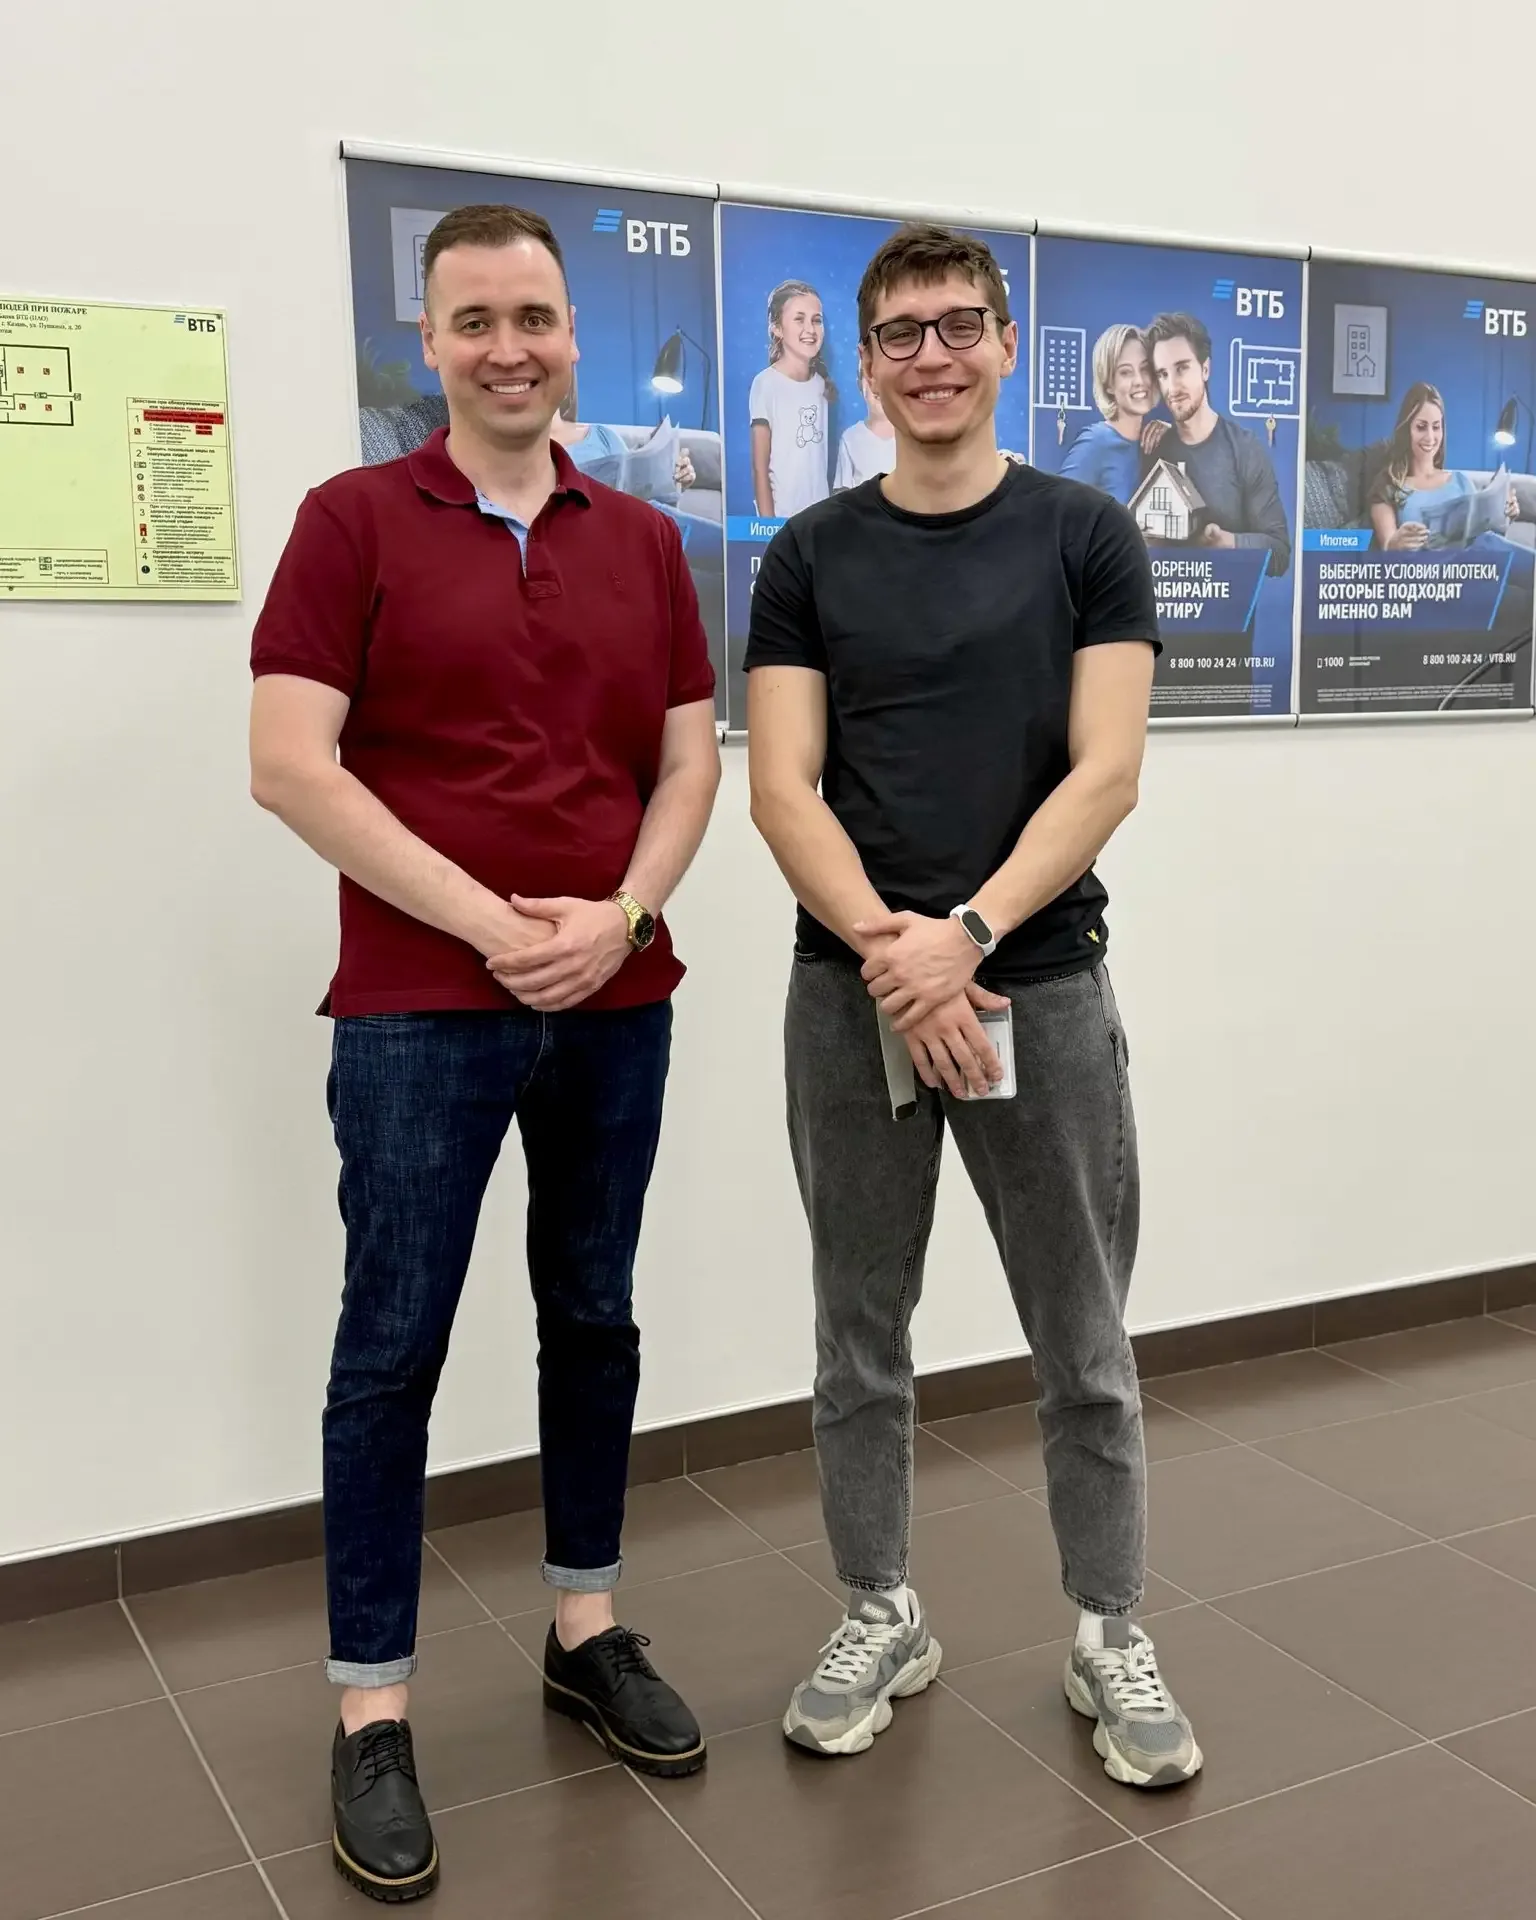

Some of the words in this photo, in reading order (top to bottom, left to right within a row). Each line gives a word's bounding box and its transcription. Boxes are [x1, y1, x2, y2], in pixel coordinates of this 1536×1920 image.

[627, 219, 691, 257] ВТБ
[31, 304, 49, 313] ПРИ
[50, 306, 88, 315] ПОЖАРЕ
[1236, 287, 1284, 319] ВТБ
[188, 318, 216, 332] ВТБ
[1485, 308, 1527, 336] ВТБ
[136, 449, 142, 457] 2
[1320, 534, 1359, 546] Ипотека
[142, 552, 148, 560] 4
[1151, 560, 1213, 578] ОБРЕНИЕ
[1319, 563, 1381, 580] ВЫБЕРИТЕ
[1384, 563, 1439, 580] УСЛОВИЯ
[1442, 563, 1500, 581] ИПОТЕКИ,
[1153, 578, 1230, 598] ЫБИРАЙТЕ
[1318, 583, 1385, 599] КОТОРЫЕ
[1388, 583, 1463, 602] ПОДХОДЯТ
[1156, 602, 1204, 619] РТИРУ
[1318, 603, 1379, 619] ИМЕННО
[1382, 603, 1412, 619] ВАМ
[1170, 658, 1176, 669] 8
[1178, 658, 1194, 669] 800
[1197, 657, 1212, 669] 100
[1213, 657, 1224, 668] 24
[1226, 657, 1237, 668] 24
[1244, 657, 1275, 668] VTB.RU
[1324, 656, 1344, 667] 1000
[1422, 655, 1428, 665] 8
[1429, 654, 1444, 665] 800
[1447, 654, 1460, 665] 100
[1461, 654, 1472, 664] 24
[1472, 653, 1482, 664] 24
[1488, 652, 1517, 664] VTB.RU
[863, 1601, 888, 1620] Kappa
